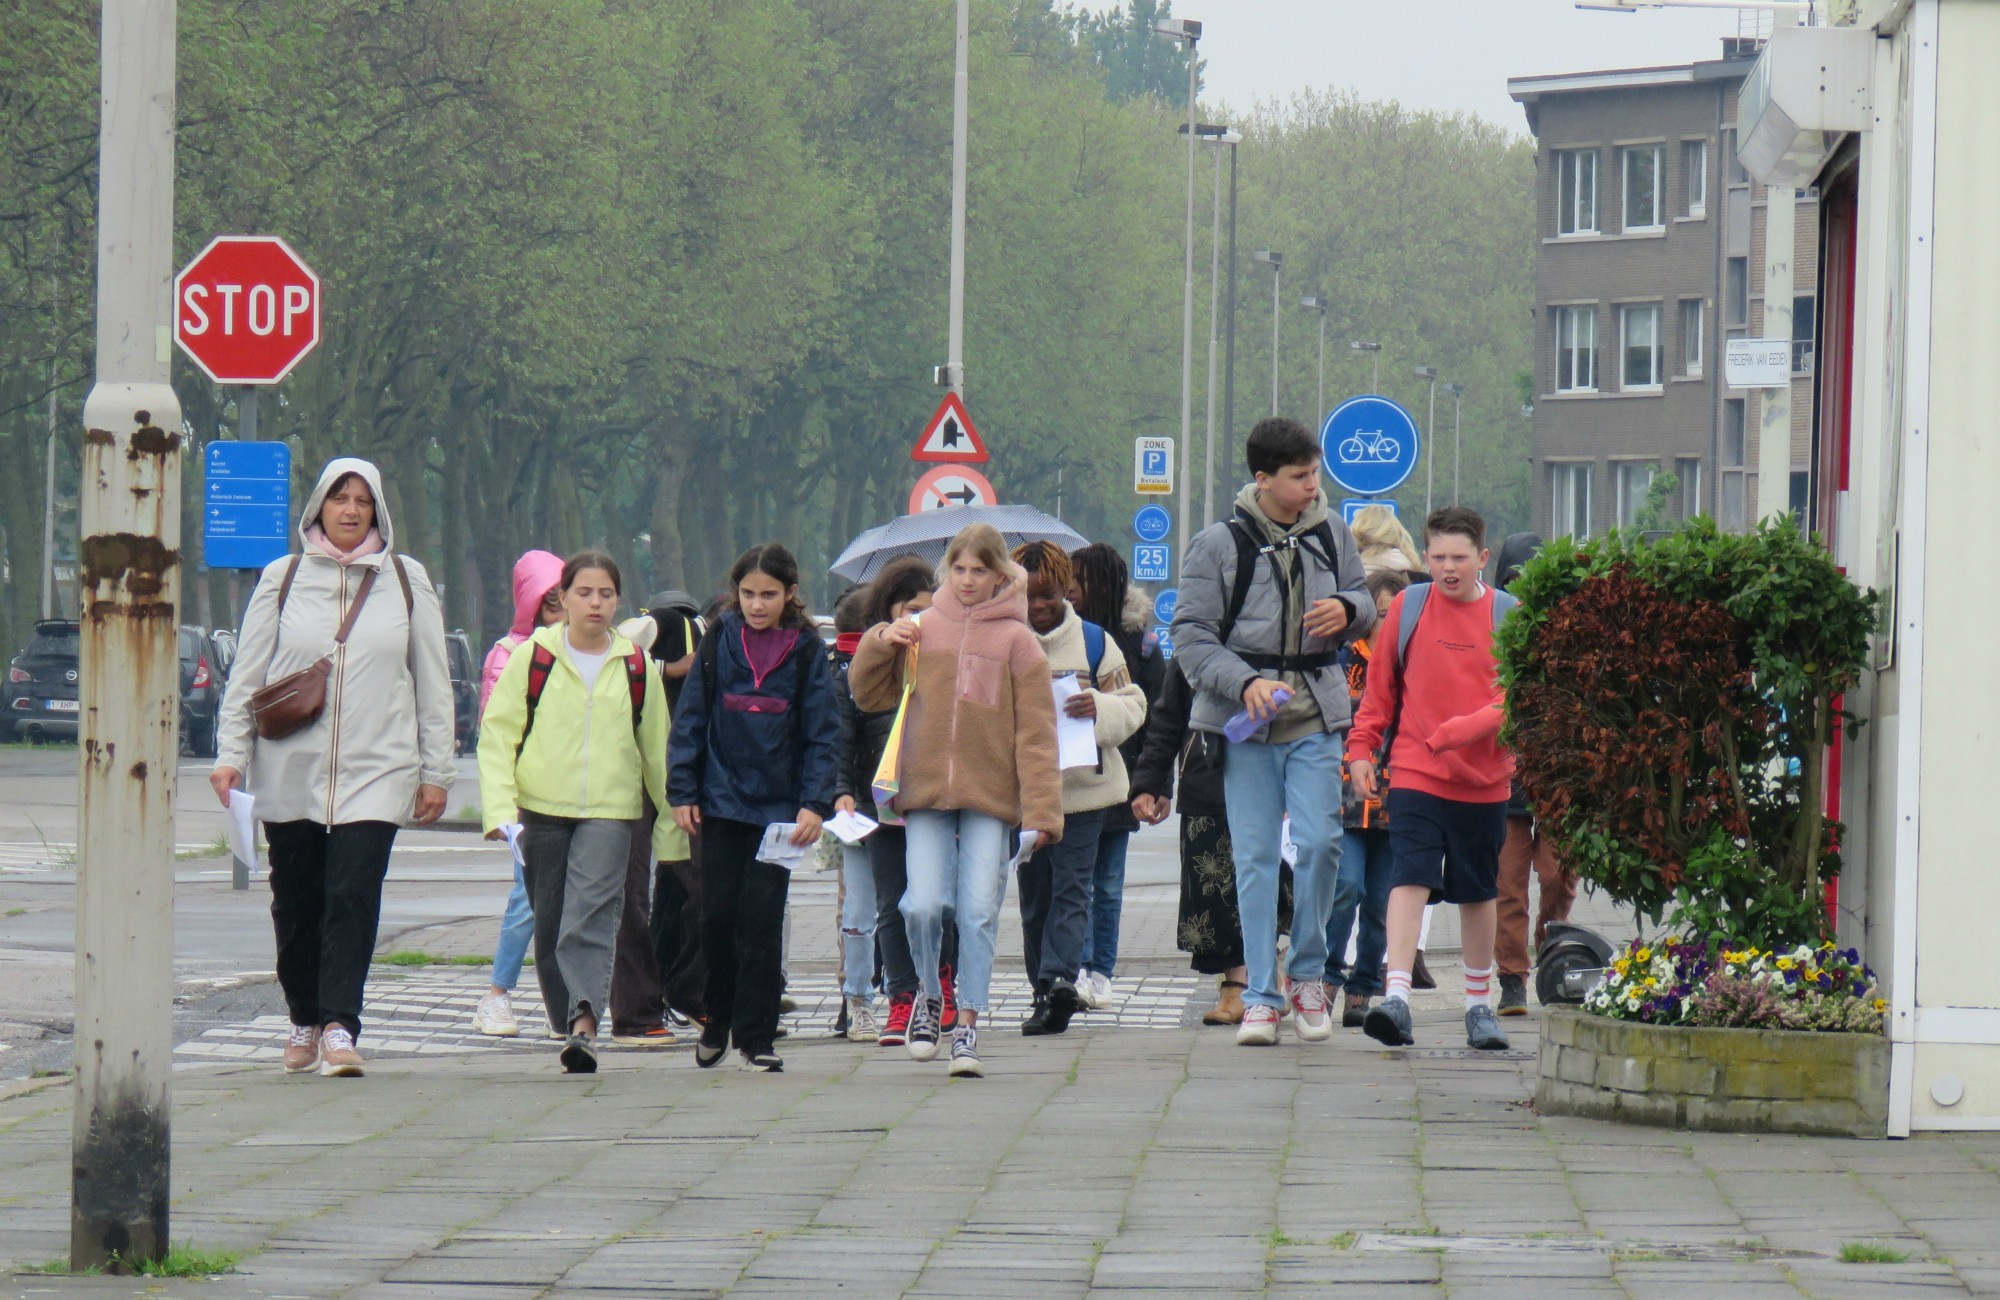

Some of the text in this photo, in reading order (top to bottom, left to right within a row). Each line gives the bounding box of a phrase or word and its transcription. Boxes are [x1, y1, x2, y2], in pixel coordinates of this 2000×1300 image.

[183, 284, 310, 336] STOP
[1144, 440, 1166, 449] ZONE
[1148, 452, 1161, 470] P
[1140, 549, 1163, 565] 25
[1137, 565, 1165, 577] km/u
[1159, 630, 1170, 645] 2
